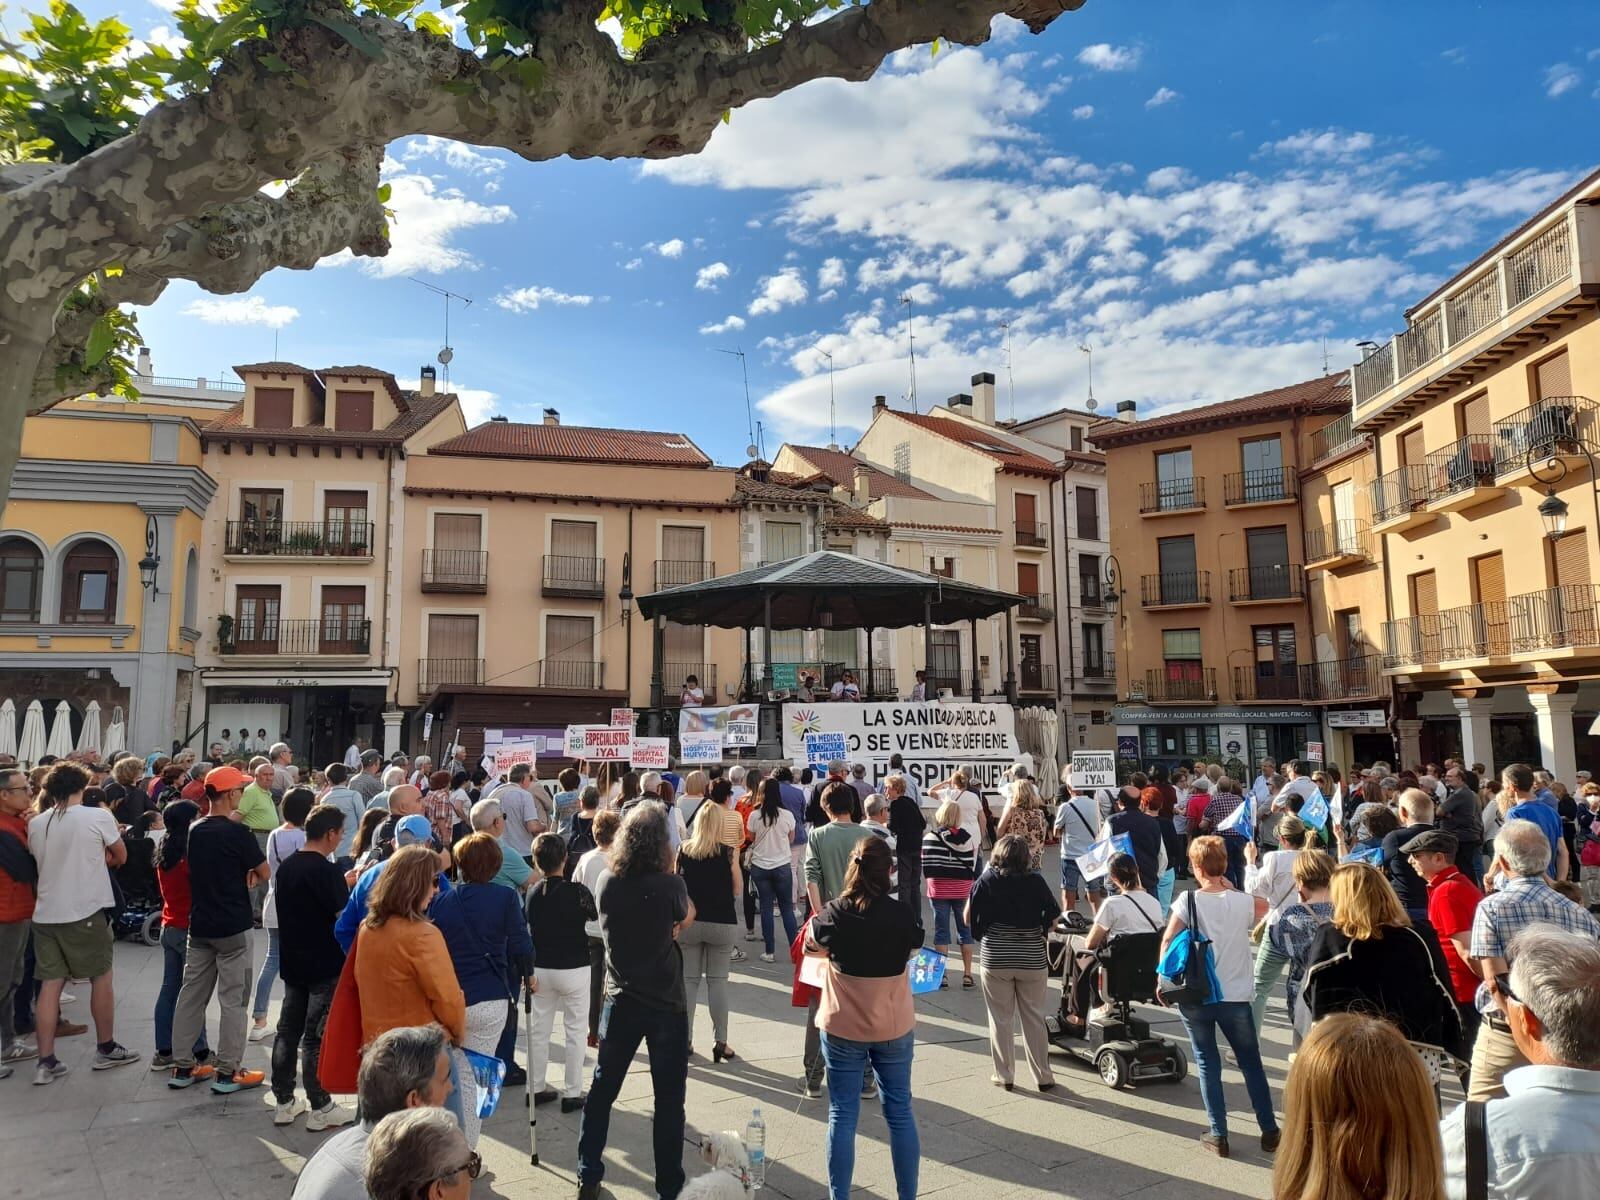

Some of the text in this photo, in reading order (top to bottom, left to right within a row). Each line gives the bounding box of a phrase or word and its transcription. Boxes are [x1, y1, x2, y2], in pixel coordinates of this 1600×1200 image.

[863, 706, 996, 726] LA SANIDAD PÚBLICA
[585, 732, 630, 746] ESPECIALISTAS
[806, 735, 816, 743] SIN
[867, 734, 890, 751] SE
[952, 734, 961, 749] SE
[596, 748, 618, 757] ¡YA!
[683, 744, 718, 752] HOSPITAL
[807, 744, 815, 752] LA
[816, 743, 844, 752] COMARCA
[497, 757, 530, 765] HOSPITAL
[808, 752, 846, 762] SE MUERE
[1073, 757, 1113, 772] ESPECIALISTAS
[873, 763, 961, 788] HSPIT
[1085, 774, 1105, 784] ¡YA!
